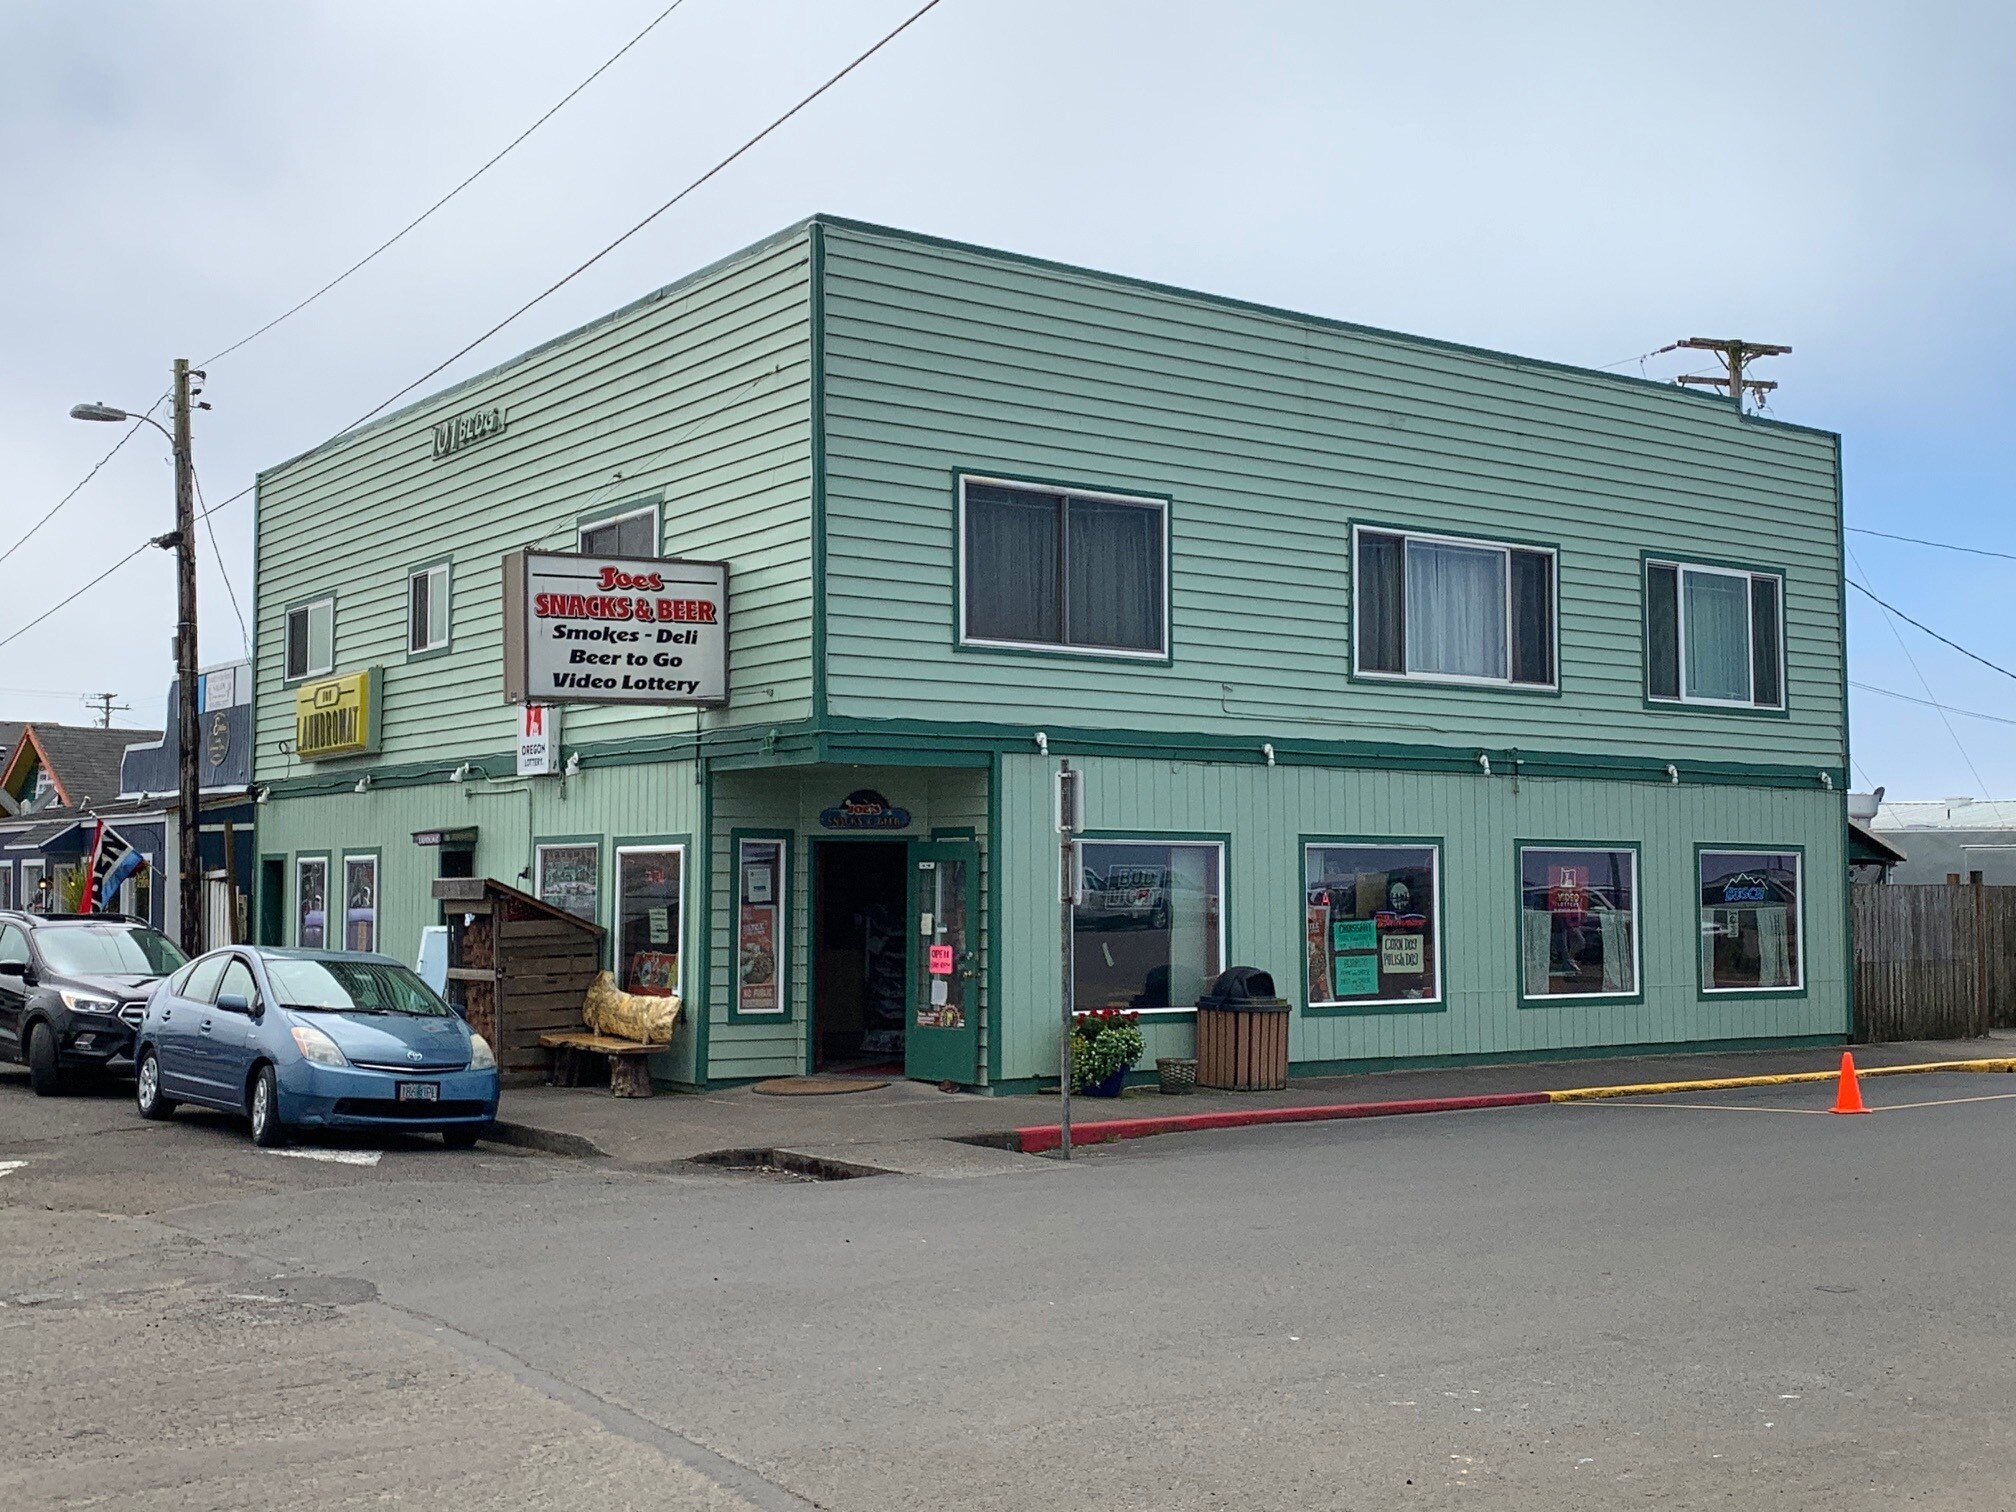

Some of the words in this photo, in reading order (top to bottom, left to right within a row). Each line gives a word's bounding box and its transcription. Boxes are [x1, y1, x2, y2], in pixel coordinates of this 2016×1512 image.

[597, 566, 665, 591] Joes
[534, 593, 633, 621] SNACKS
[634, 597, 655, 623] &
[656, 598, 717, 624] BEER
[553, 624, 639, 644] Smokes
[656, 629, 698, 645] Deli
[569, 650, 621, 666] Beer
[626, 652, 648, 667] to
[653, 652, 683, 668] Go
[553, 673, 617, 689] Video
[621, 675, 700, 694] Lottery
[521, 743, 546, 756] OREGON
[1557, 892, 1580, 903] VIDEO
[1725, 886, 1765, 901] BUSCH
[931, 949, 950, 959] OPEN
